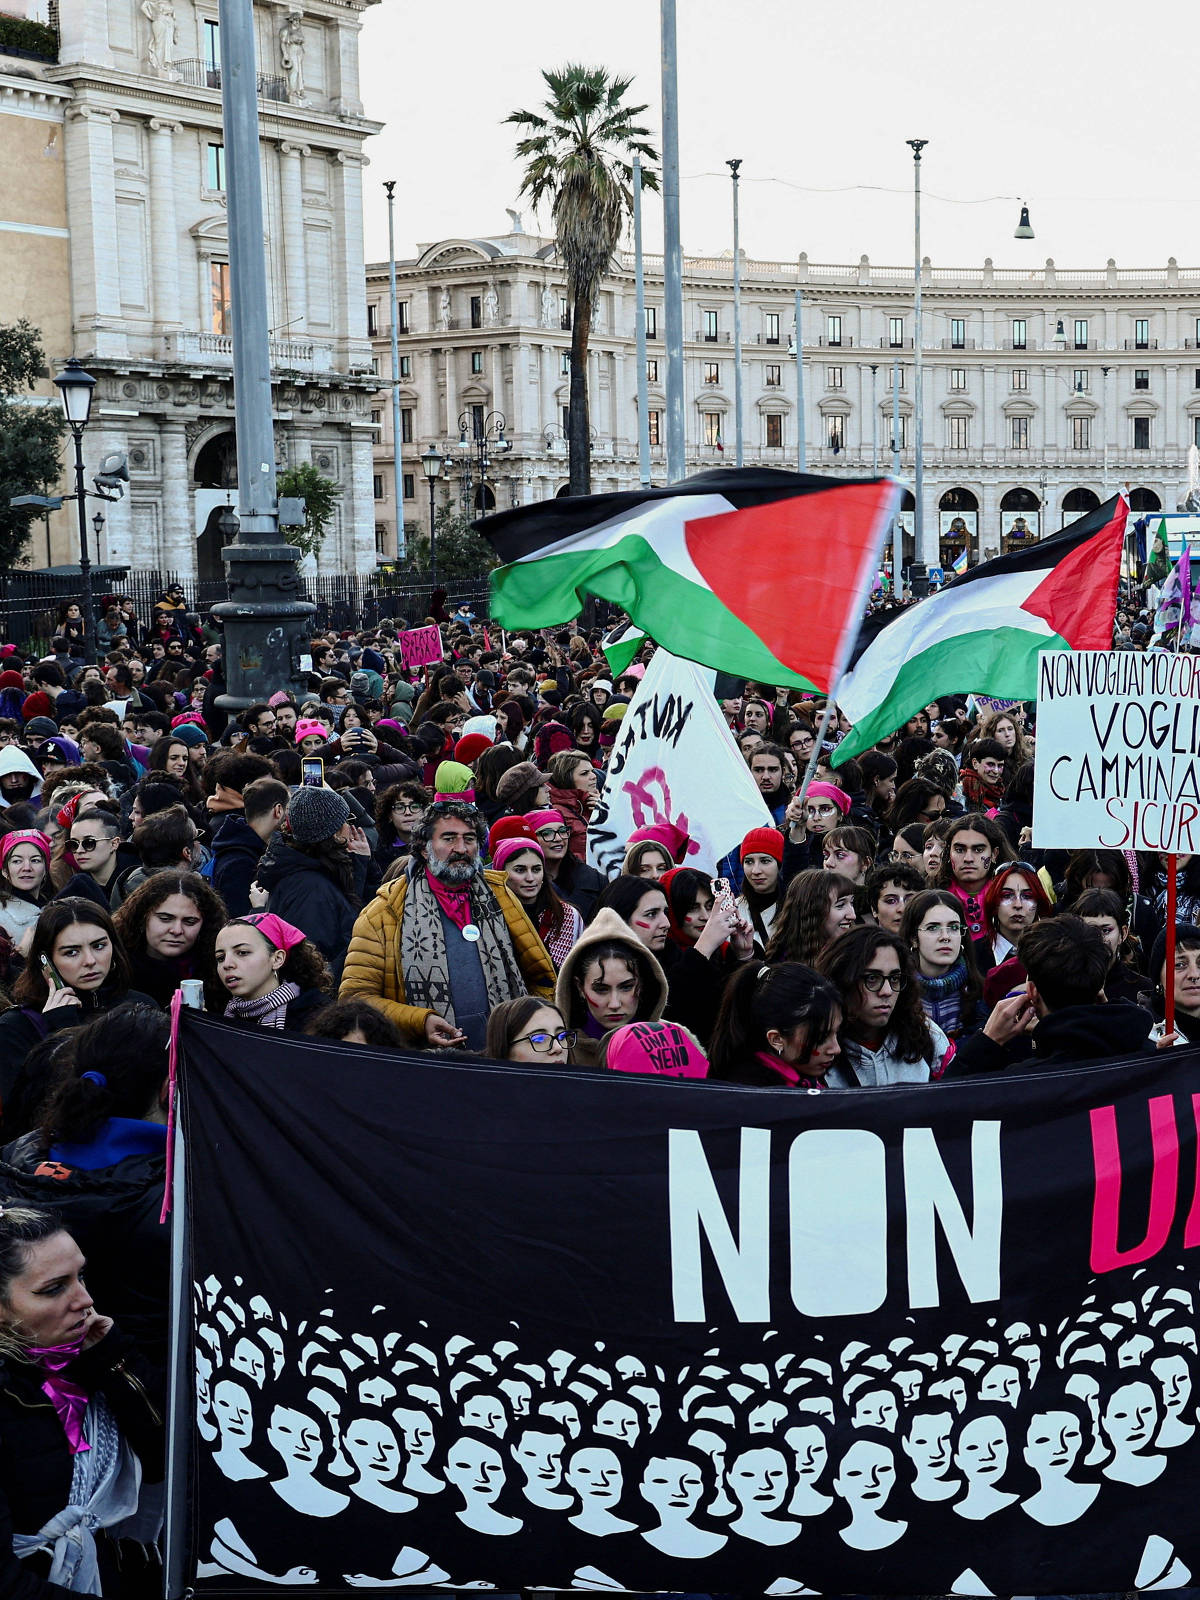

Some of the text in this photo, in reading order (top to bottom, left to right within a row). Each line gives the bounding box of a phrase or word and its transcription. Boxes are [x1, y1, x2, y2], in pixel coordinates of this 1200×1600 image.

[1041, 654, 1081, 702] NON
[1086, 652, 1168, 697] VOGLIAMO
[640, 1029, 684, 1053] UNA DI
[650, 1046, 688, 1070] MENO
[669, 1120, 1002, 1322] NON
